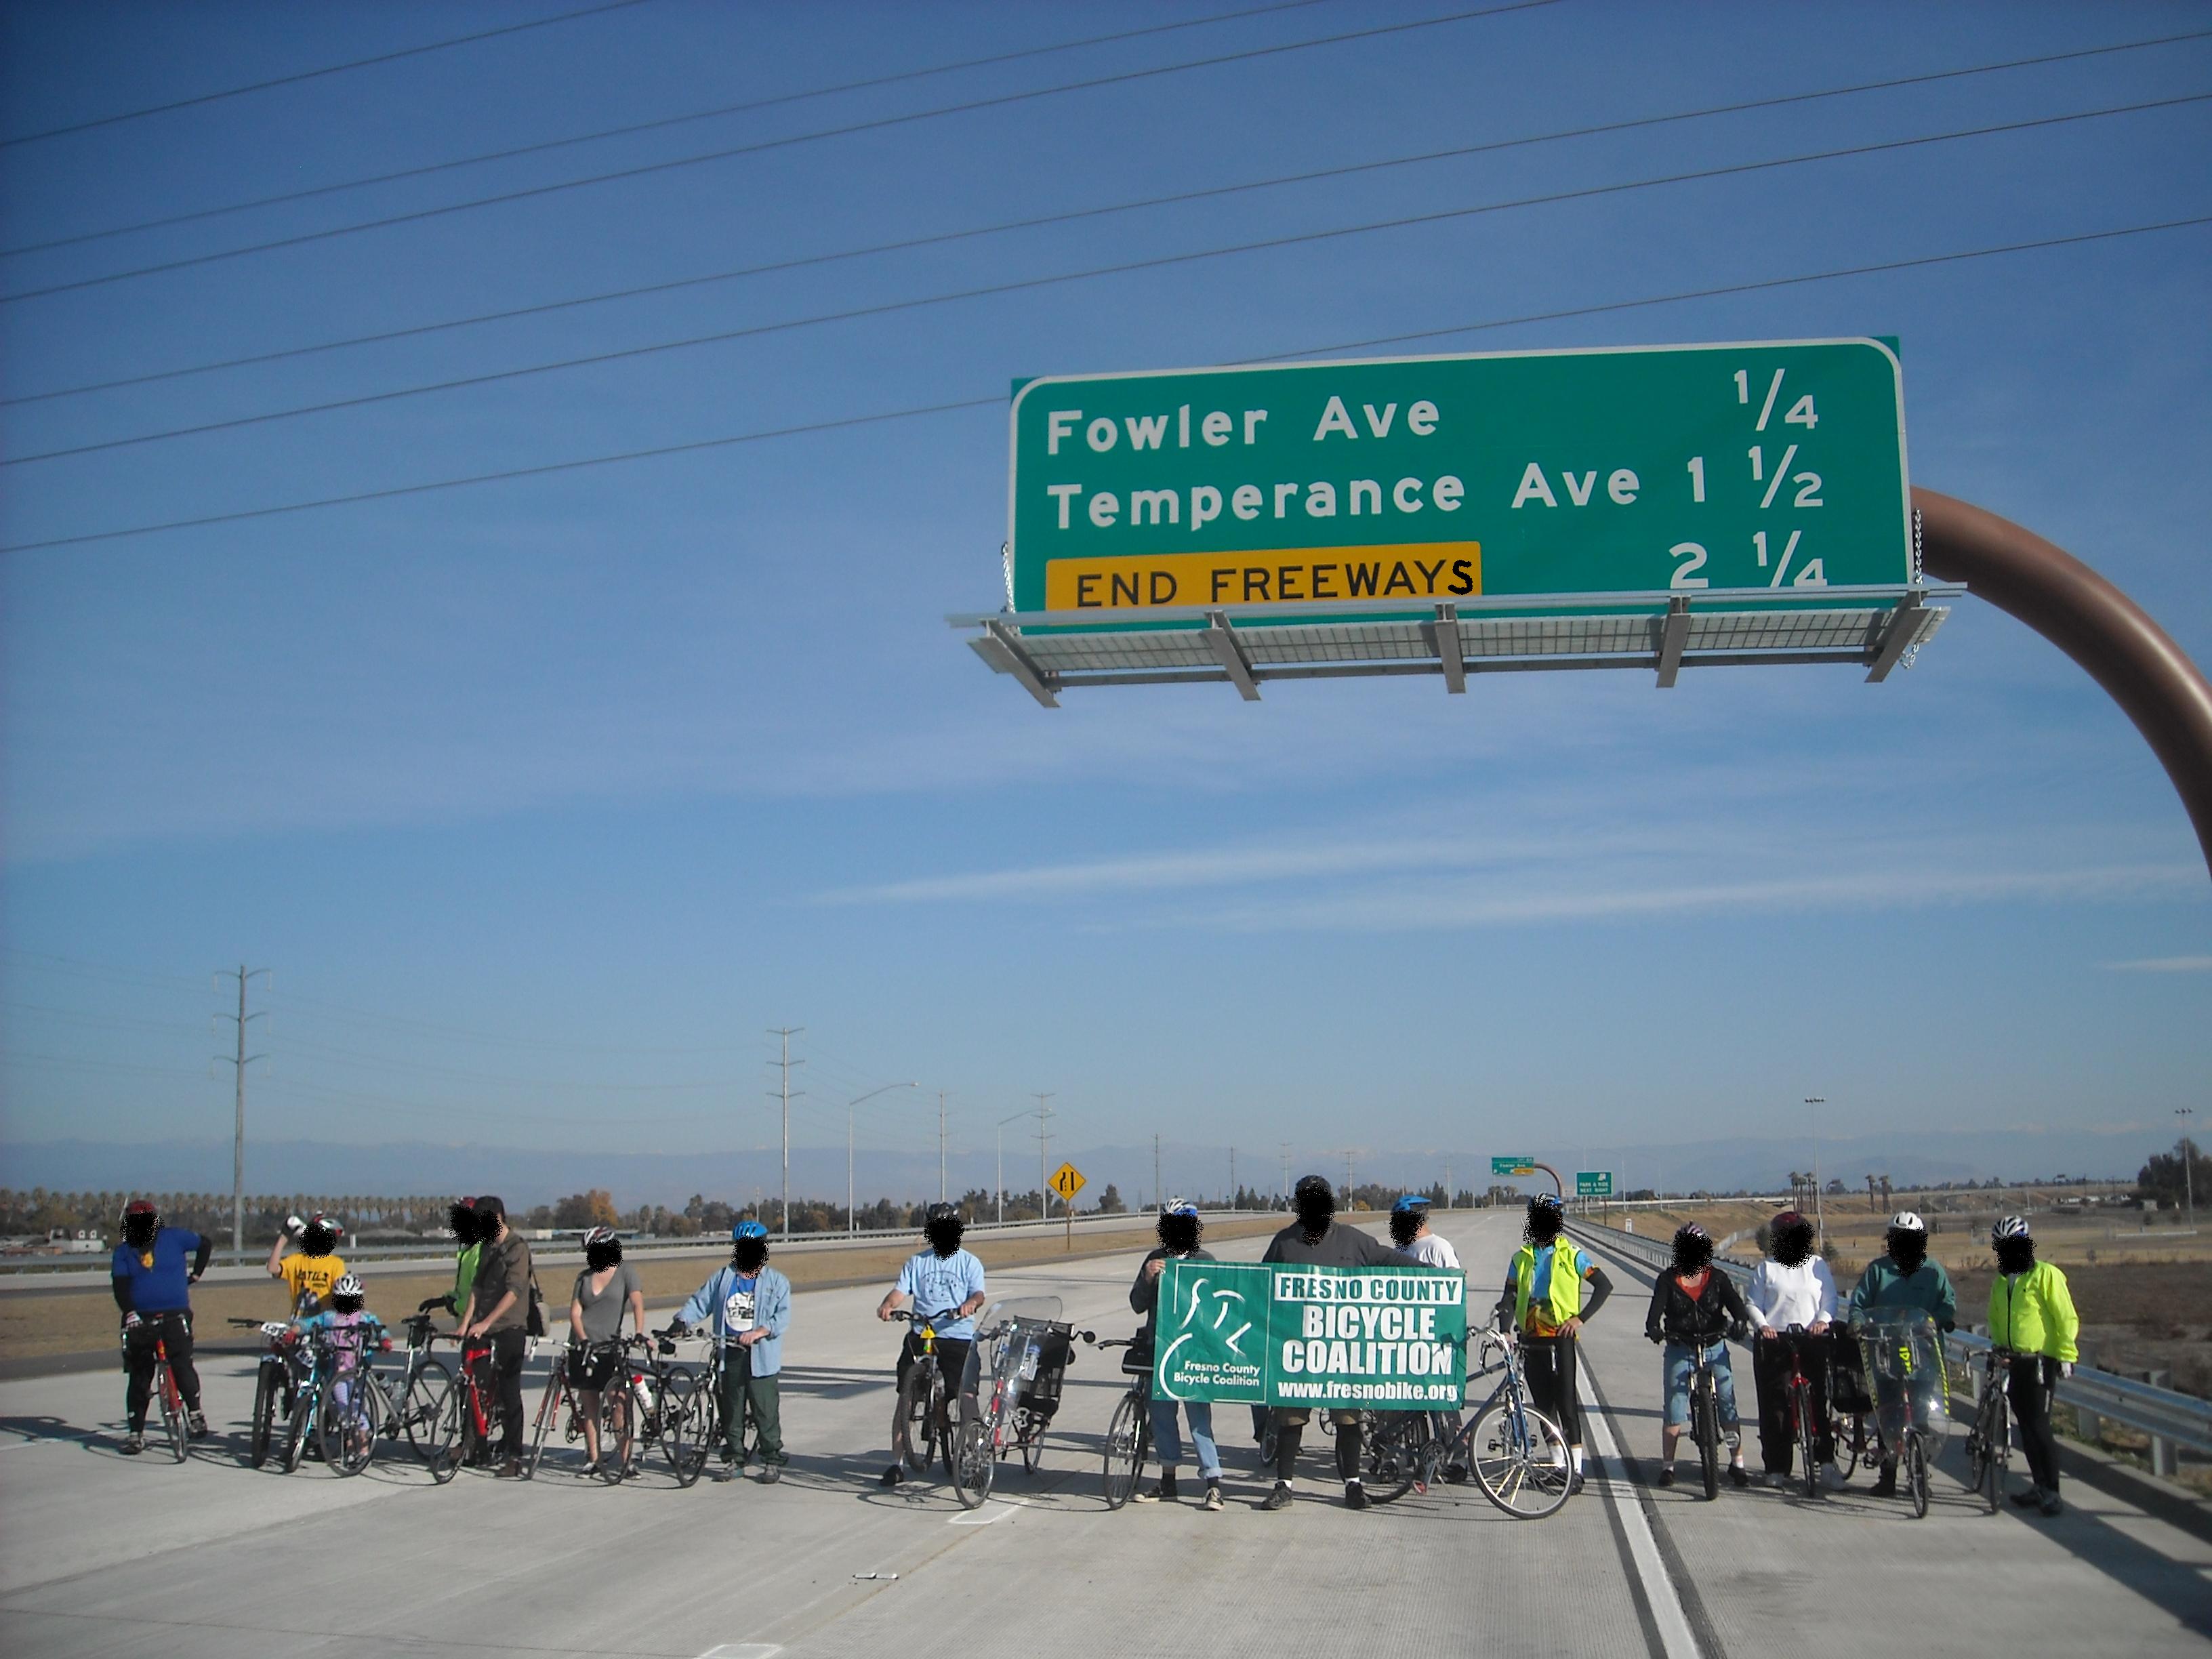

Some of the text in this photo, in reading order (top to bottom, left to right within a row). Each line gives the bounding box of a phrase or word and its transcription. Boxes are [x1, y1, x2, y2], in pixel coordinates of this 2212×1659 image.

[1048, 405, 1267, 454] Fowler
[1313, 396, 1439, 441] Ave
[1047, 476, 1465, 531] Temperance
[1511, 462, 1639, 508] Ave
[1687, 457, 1705, 502] 1
[1077, 559, 1474, 608] END FREEWAYS
[1669, 542, 1708, 589] 2
[1280, 1277, 1458, 1301] FRESNO COUNTY
[1303, 1305, 1436, 1340] BICYCLE
[1184, 1360, 1261, 1377] Fresno County
[1282, 1339, 1452, 1376] COALITION
[1173, 1371, 1260, 1387] Bicycle Coalition
[1277, 1380, 1458, 1402] www.fresnobike.org
